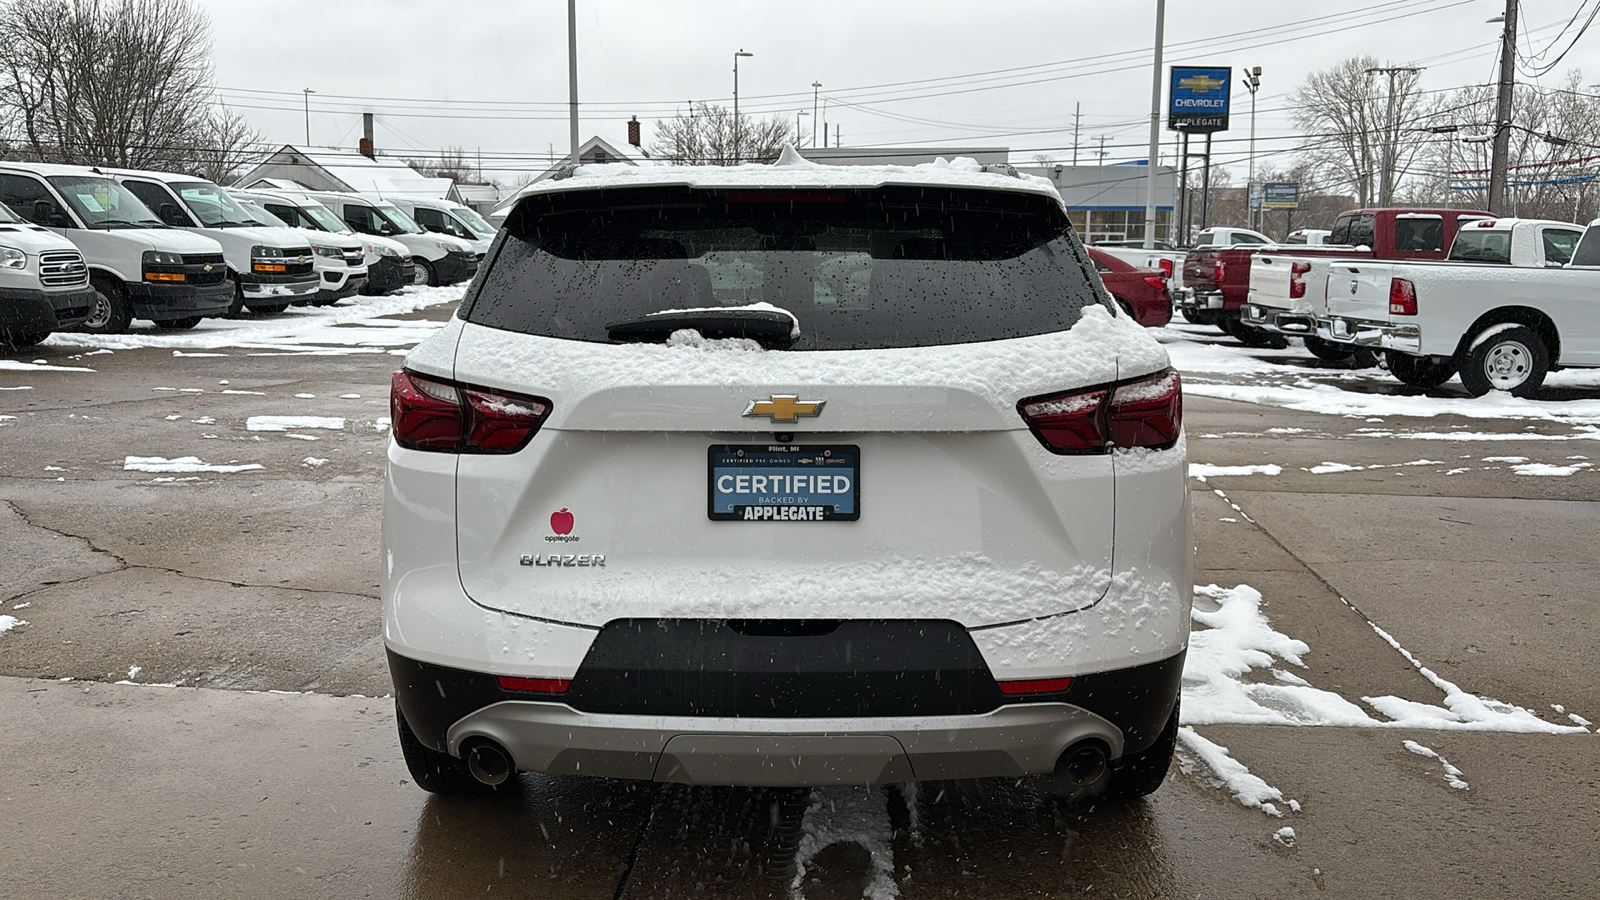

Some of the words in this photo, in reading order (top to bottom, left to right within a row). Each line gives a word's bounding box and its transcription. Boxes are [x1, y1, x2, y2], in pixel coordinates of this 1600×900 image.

[1175, 99, 1224, 108] CHEVROLET
[717, 475, 851, 494] CERTIFIED
[758, 496, 795, 504] BACKED
[797, 496, 810, 504] BY
[743, 506, 824, 521] APPLEGATE
[544, 535, 580, 543] applegate
[519, 553, 606, 567] BLAZER
